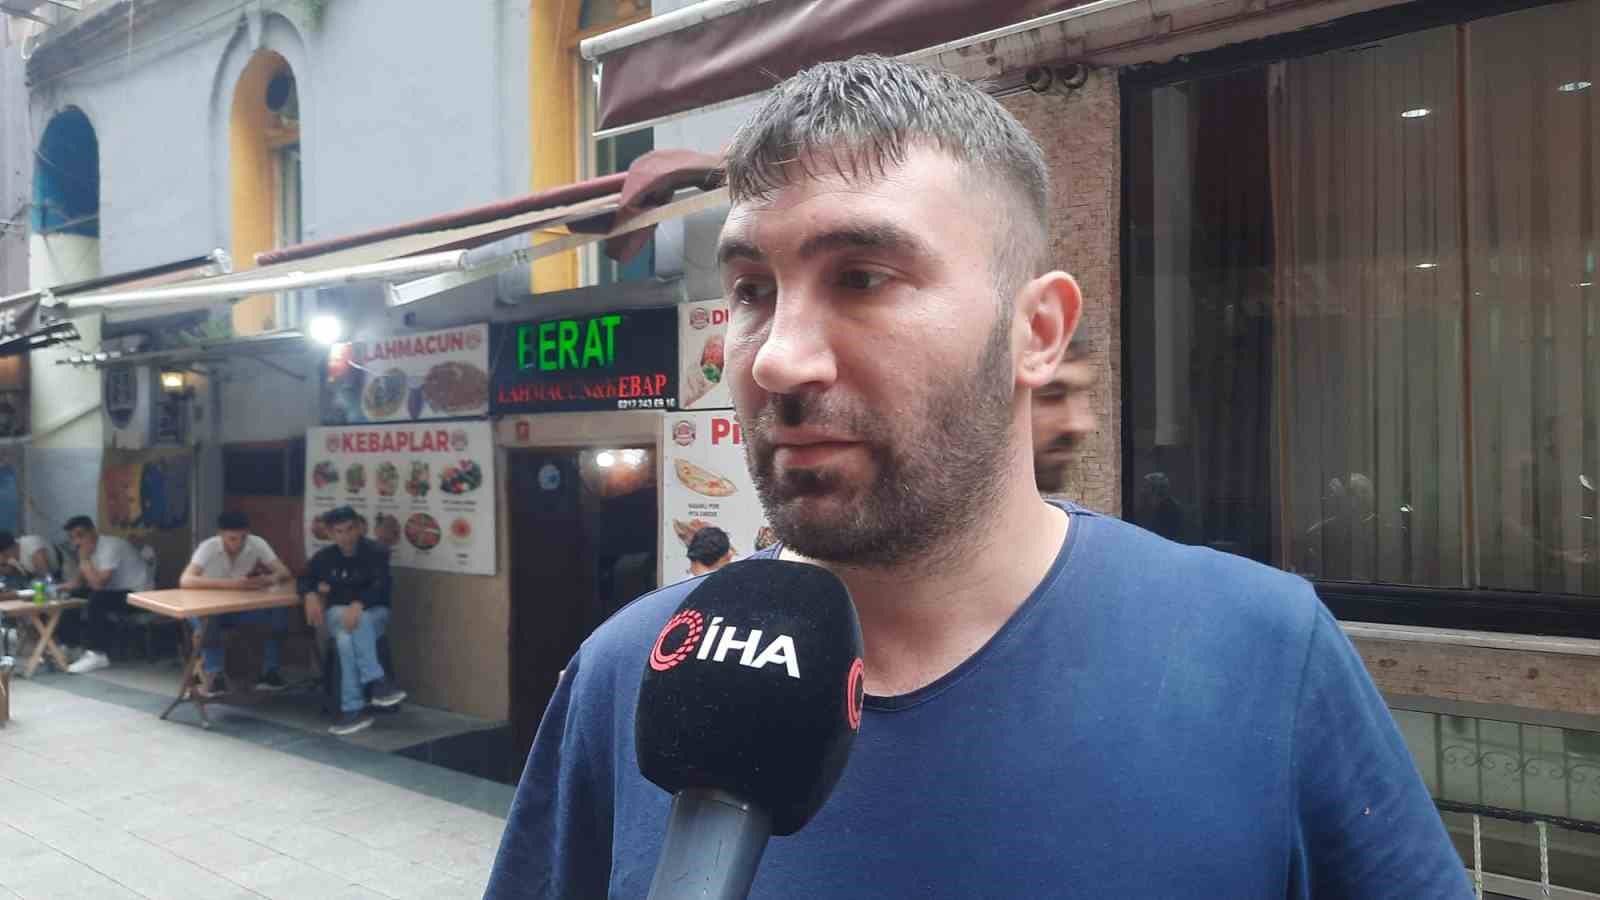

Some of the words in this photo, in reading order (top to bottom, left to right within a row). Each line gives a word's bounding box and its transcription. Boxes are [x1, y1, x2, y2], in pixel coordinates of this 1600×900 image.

[362, 331, 465, 361] LAHMACUN
[518, 315, 621, 369] BERAT
[341, 430, 450, 453] KEBAPLAR
[697, 616, 800, 677] İHA
